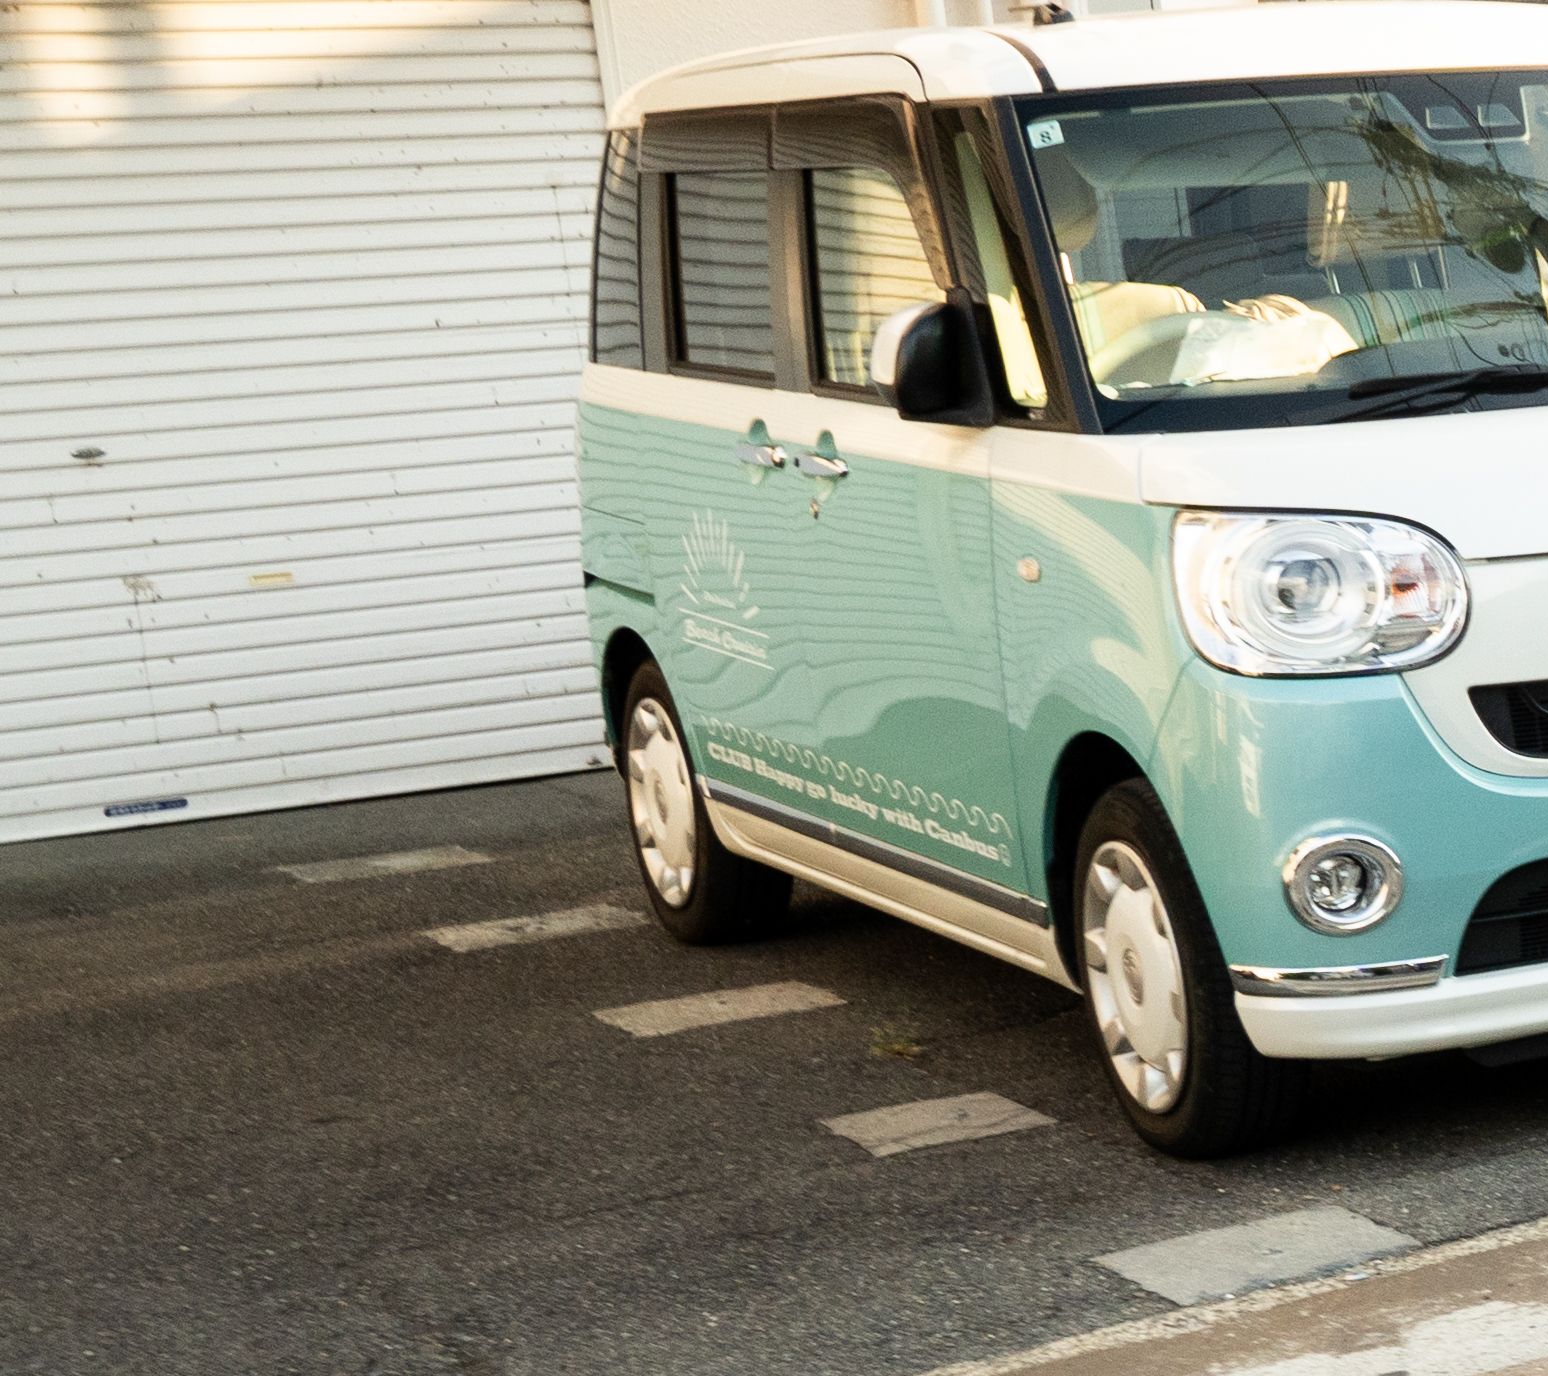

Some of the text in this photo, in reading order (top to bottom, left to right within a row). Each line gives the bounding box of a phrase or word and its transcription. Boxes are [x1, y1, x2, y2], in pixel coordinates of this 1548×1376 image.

[707, 741, 1000, 862] CLUB Happy go lucky with Canbus
